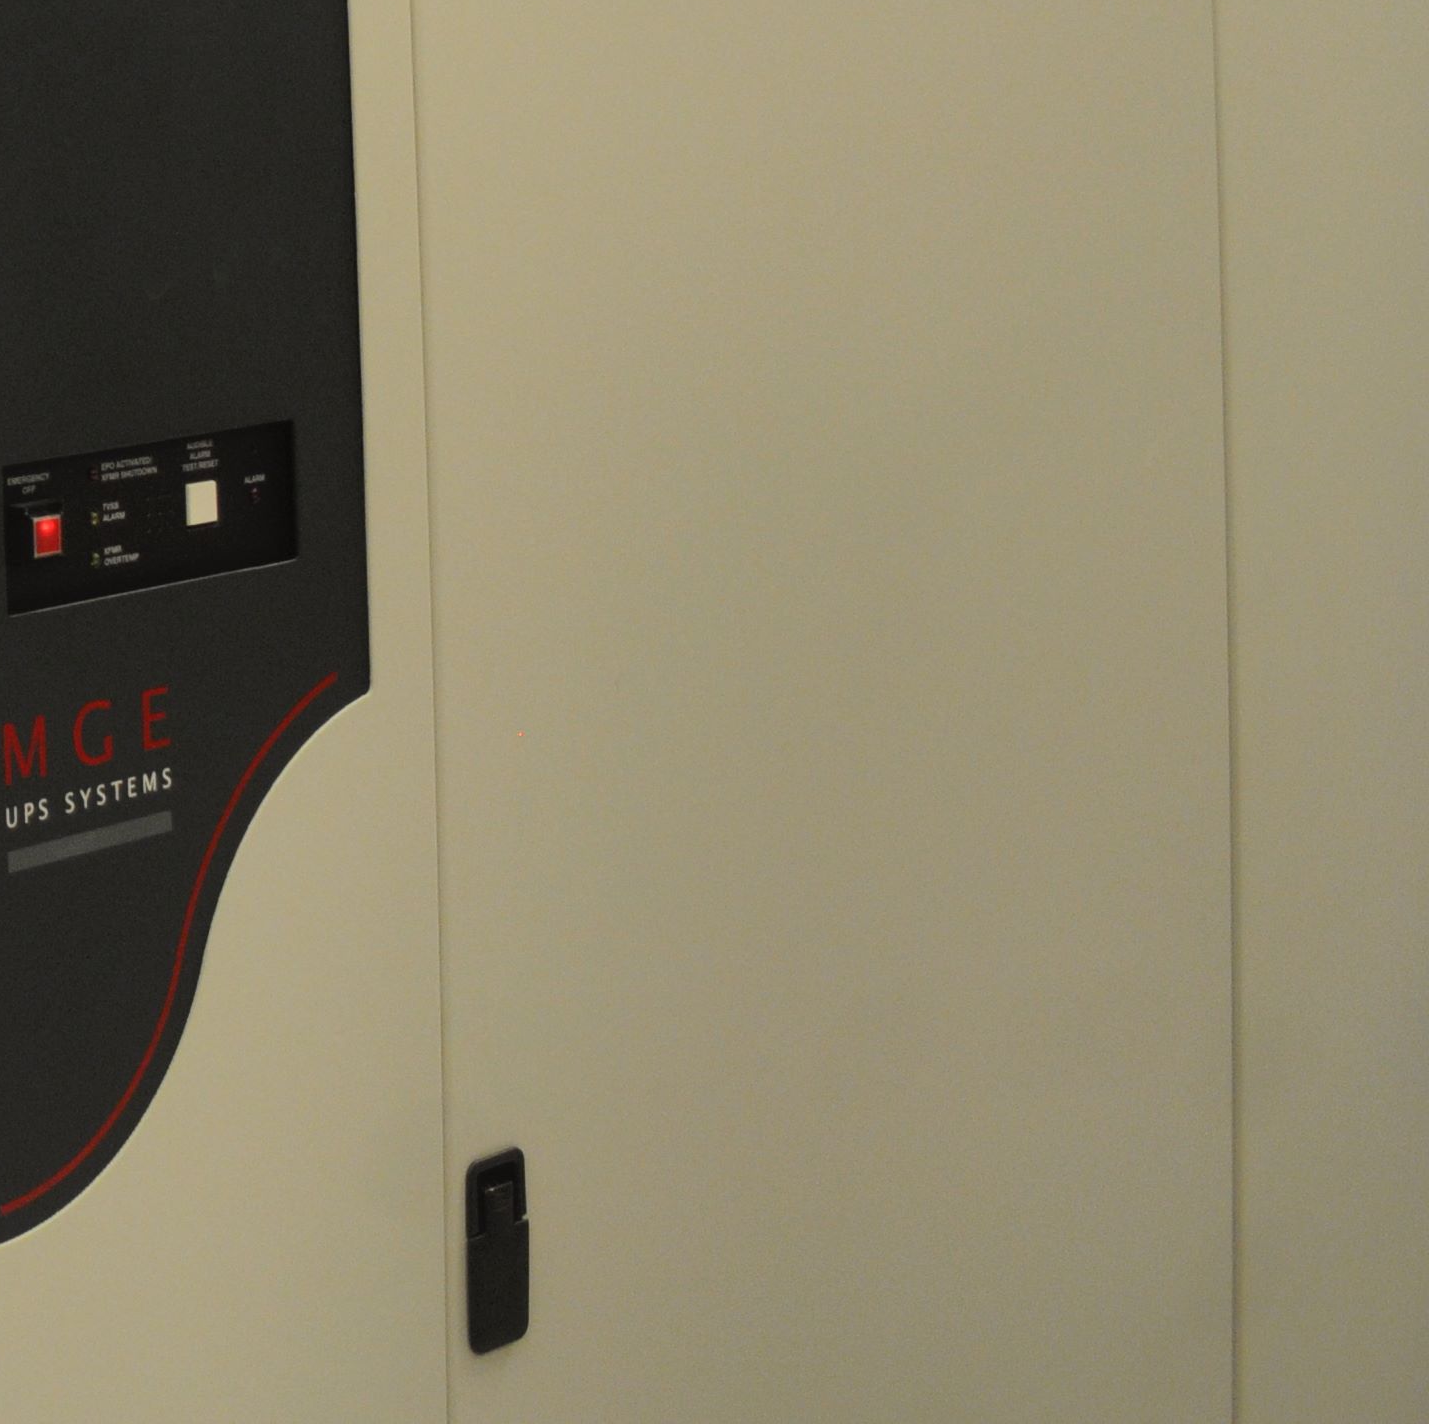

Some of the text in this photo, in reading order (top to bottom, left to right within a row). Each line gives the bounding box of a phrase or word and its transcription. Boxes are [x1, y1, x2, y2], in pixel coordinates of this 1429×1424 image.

[7, 472, 50, 486] EMERGENCY
[244, 474, 266, 484] ALARM
[22, 485, 36, 495] OFF
[102, 511, 126, 522] ALARM
[104, 553, 140, 566] OVERTEMP
[2, 683, 172, 787] MGE
[5, 767, 173, 829] UPS SYSTEMS
